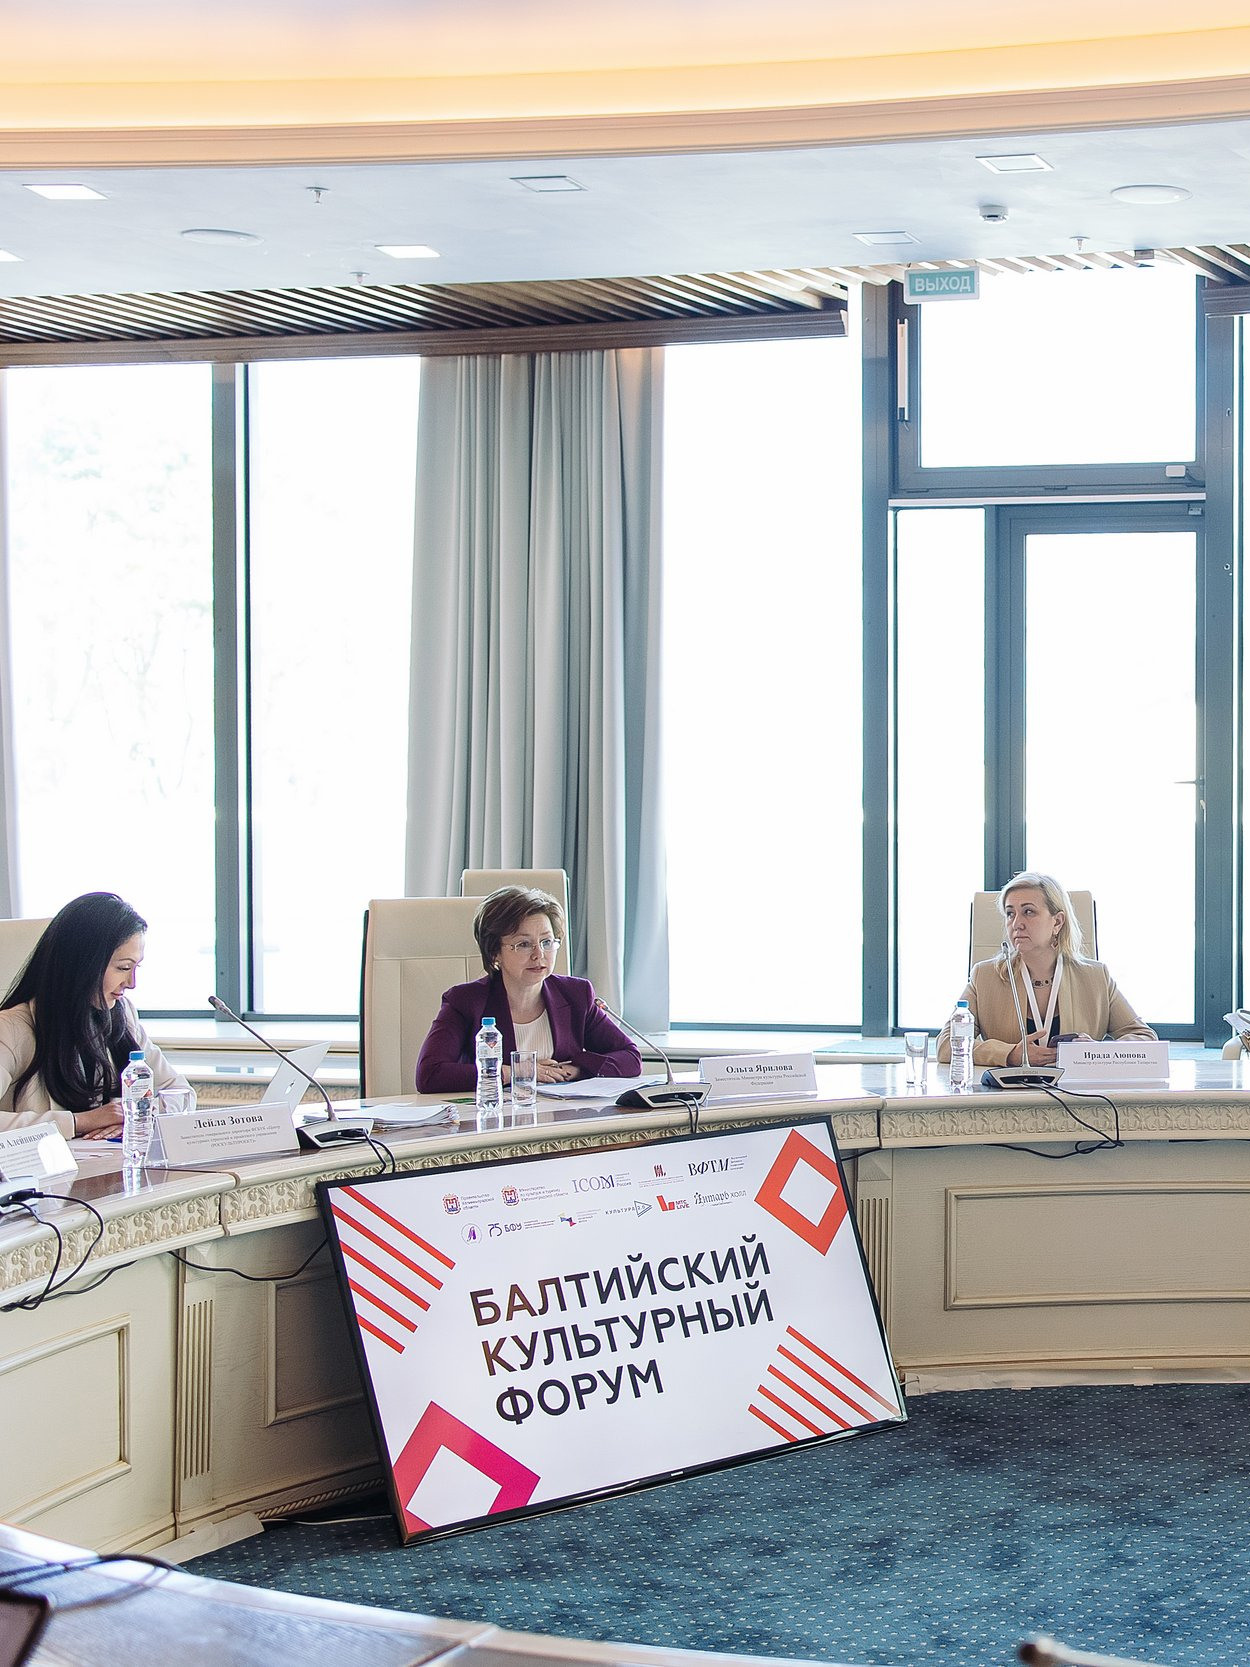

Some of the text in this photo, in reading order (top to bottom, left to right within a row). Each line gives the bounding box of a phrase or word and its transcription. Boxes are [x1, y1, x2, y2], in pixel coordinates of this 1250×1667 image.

[915, 276, 971, 292] ВЫХОД
[1084, 1052, 1146, 1060] Ирада Аюпова
[726, 1064, 793, 1074] Ольга Ярилова
[194, 1115, 263, 1129] Лейла Зотова
[688, 1158, 729, 1176] ВФТМ
[572, 1174, 615, 1193] ICOM
[488, 1223, 502, 1237] 75
[469, 1233, 771, 1327] БАЛТИЙСКИЙ
[481, 1281, 774, 1377] КУЛЬТУРНЫЙ
[495, 1358, 664, 1426] ФОРУМ
